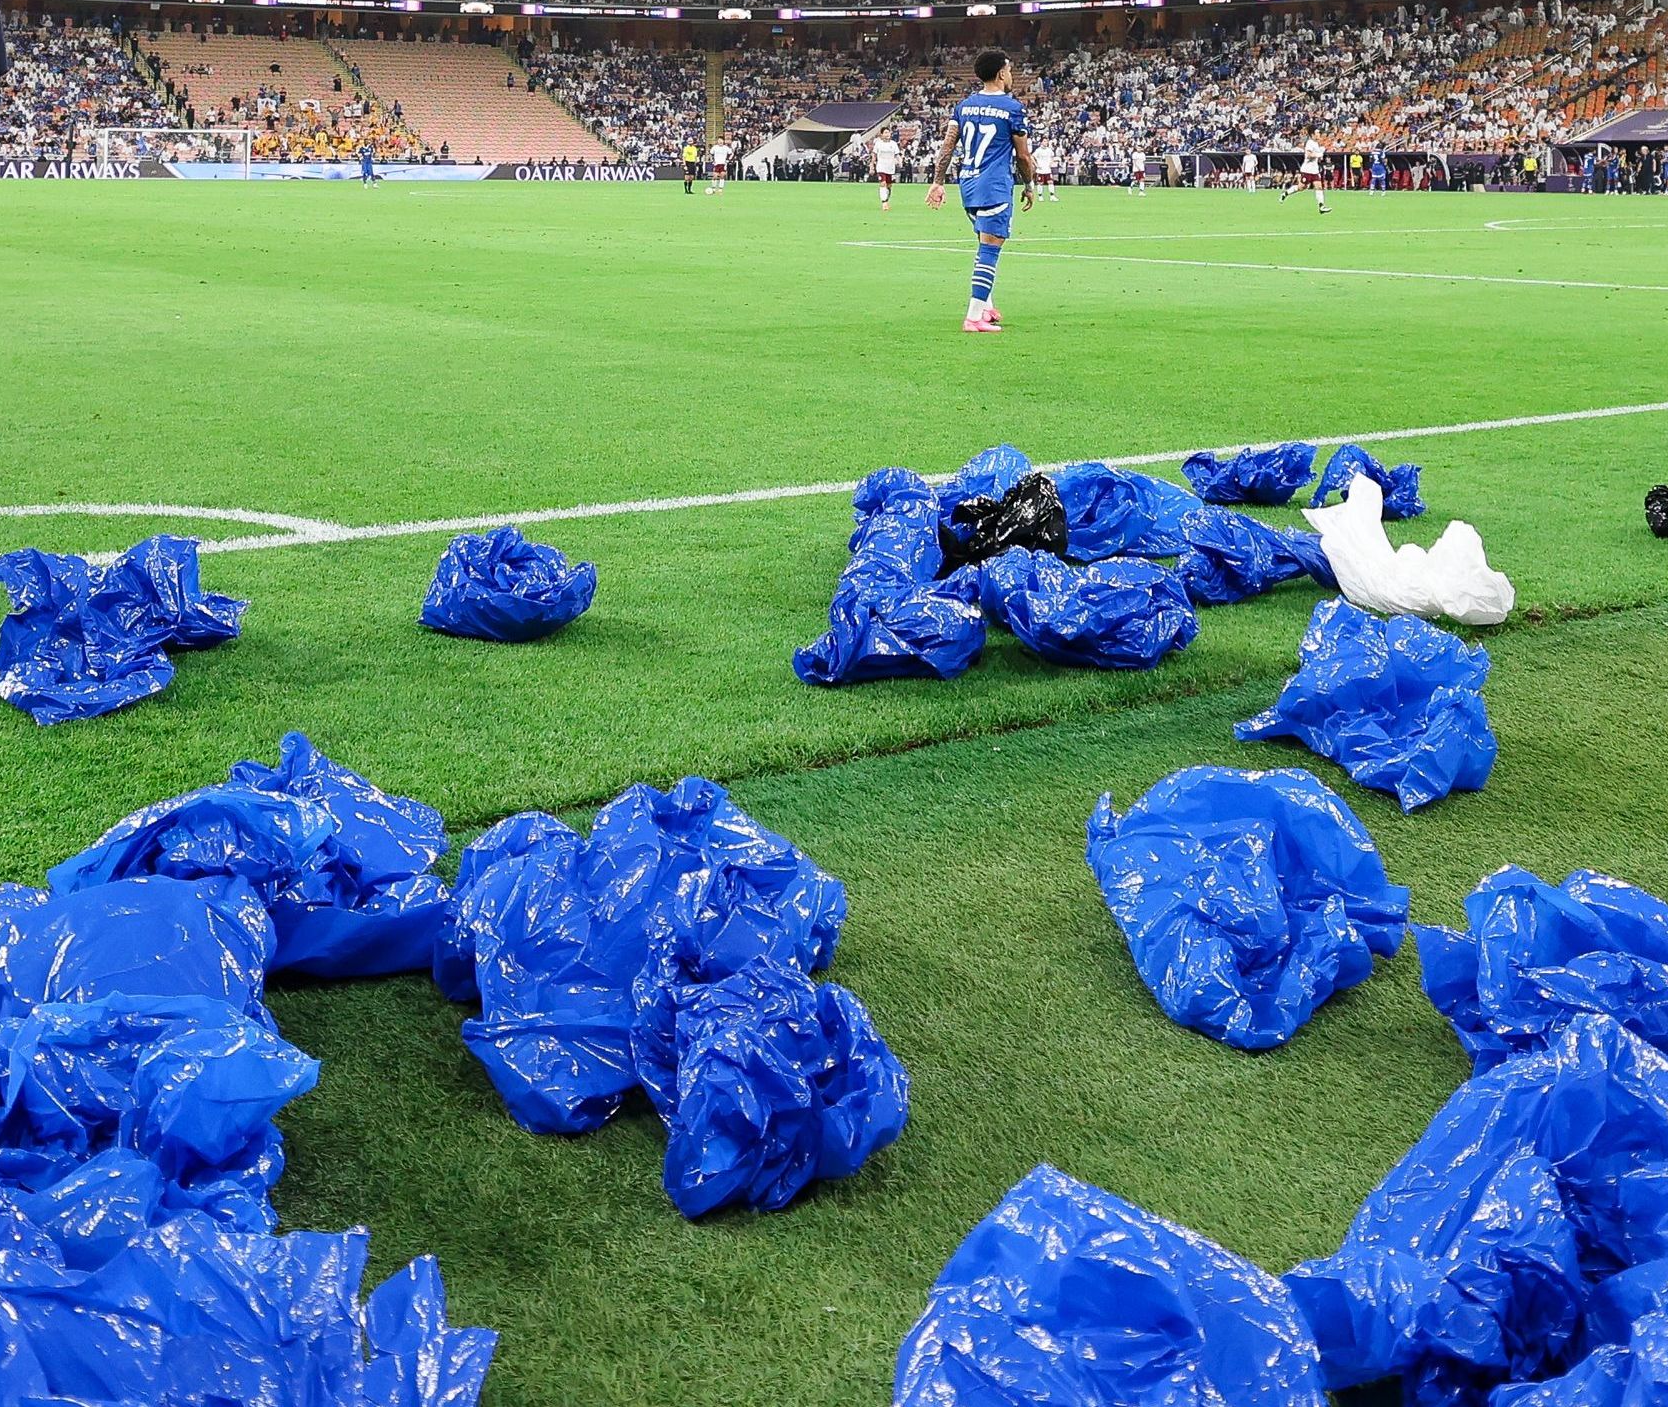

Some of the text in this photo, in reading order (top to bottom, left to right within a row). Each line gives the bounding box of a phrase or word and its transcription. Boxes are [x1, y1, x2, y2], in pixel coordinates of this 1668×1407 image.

[962, 121, 997, 168] 27
[44, 161, 141, 179] AIRWAYS
[514, 165, 655, 181] QATAR AIRWAYS
